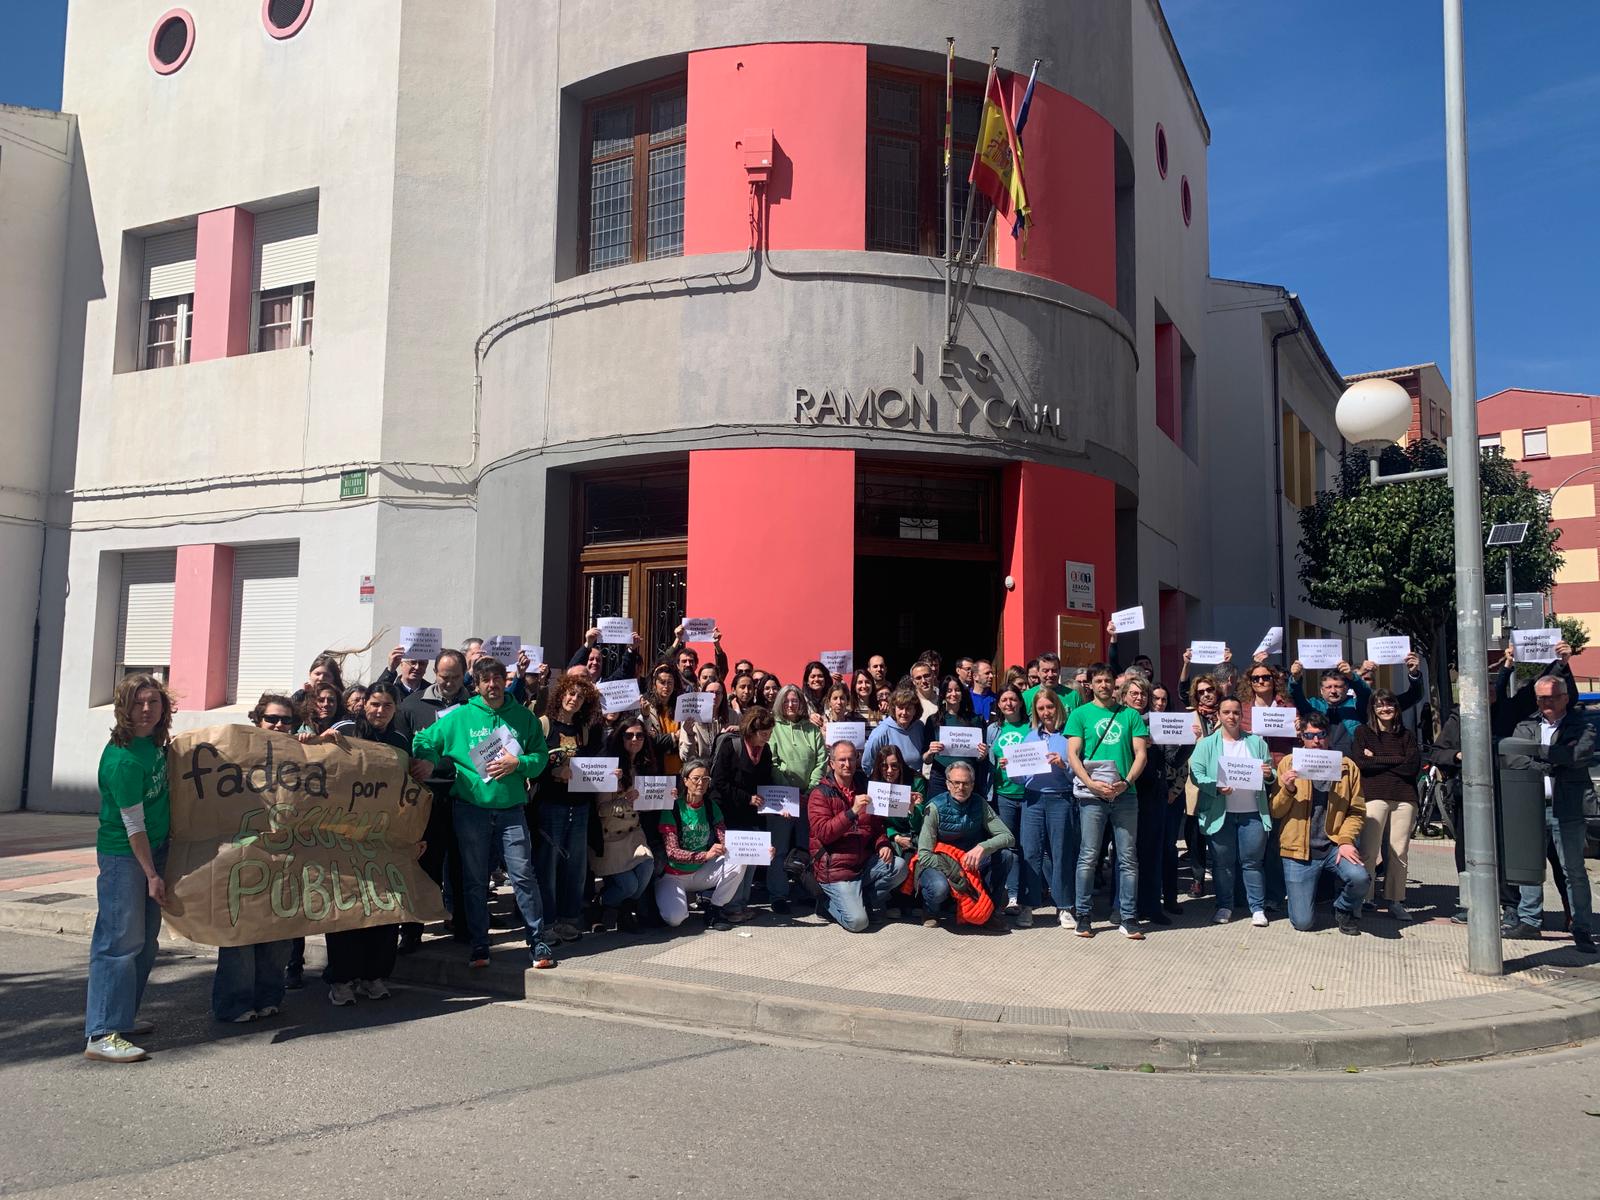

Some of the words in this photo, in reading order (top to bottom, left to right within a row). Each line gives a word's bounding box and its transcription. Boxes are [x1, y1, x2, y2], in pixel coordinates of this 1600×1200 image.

[794, 386, 931, 421] RAMON
[949, 392, 972, 424] Y
[984, 397, 1067, 439] CAJAL
[183, 740, 328, 799] fadea
[349, 780, 388, 811] por
[399, 773, 422, 807] la
[231, 803, 392, 859] ESCUELA
